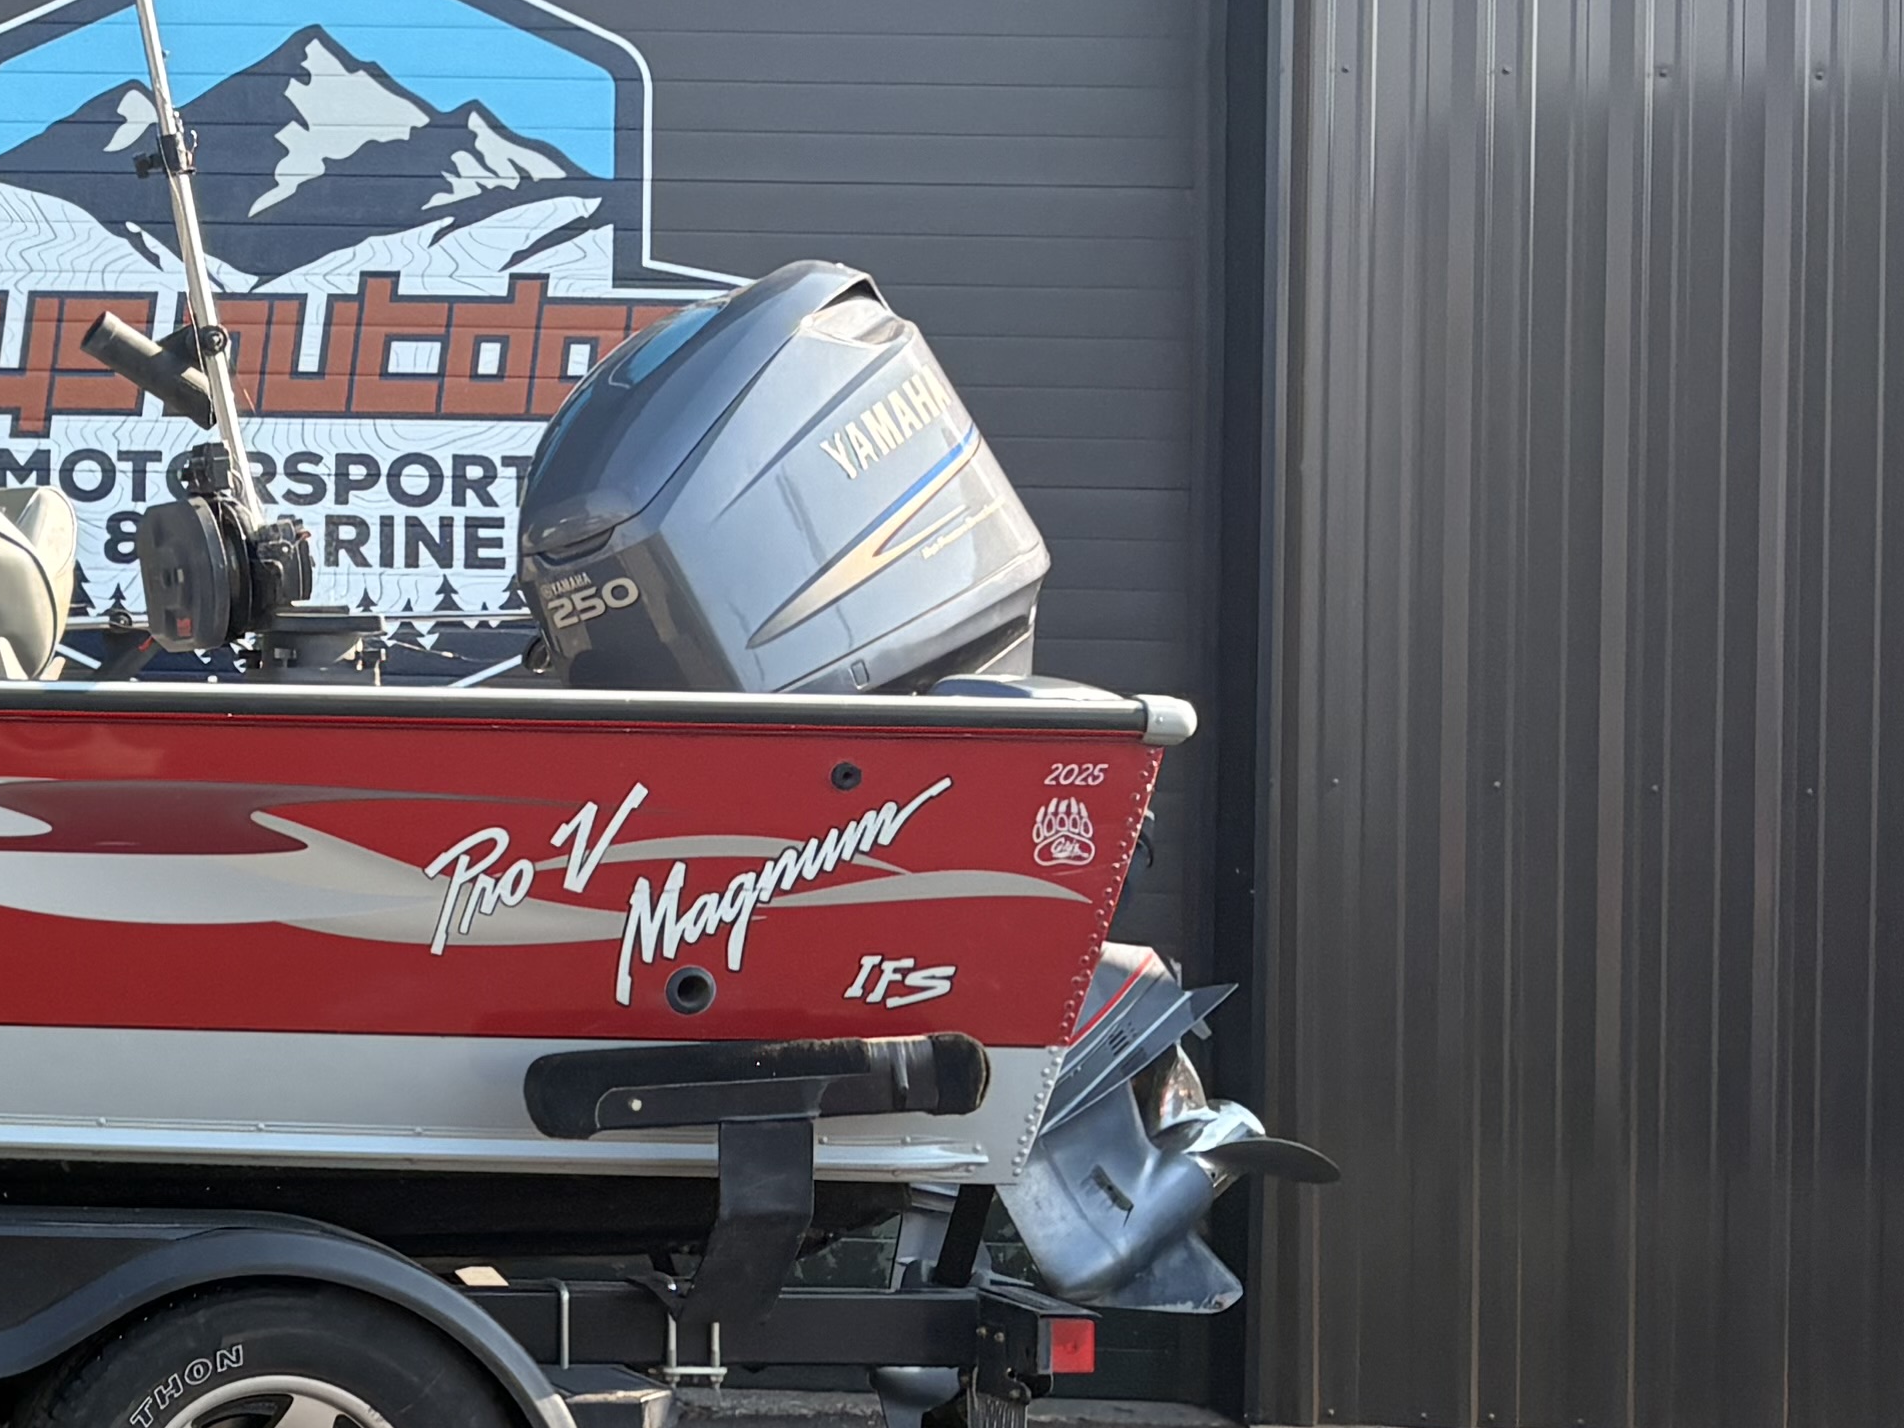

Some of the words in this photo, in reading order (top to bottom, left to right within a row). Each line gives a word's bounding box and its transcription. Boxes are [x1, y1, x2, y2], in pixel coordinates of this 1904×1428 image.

[820, 364, 952, 480] YAMAHA
[276, 514, 507, 569] RINE
[547, 577, 640, 629] 250
[1043, 763, 1109, 786] 2025
[423, 826, 535, 956] Pro
[548, 781, 649, 894] V
[615, 776, 953, 1006] Magnum
[843, 955, 957, 1008] IFS
